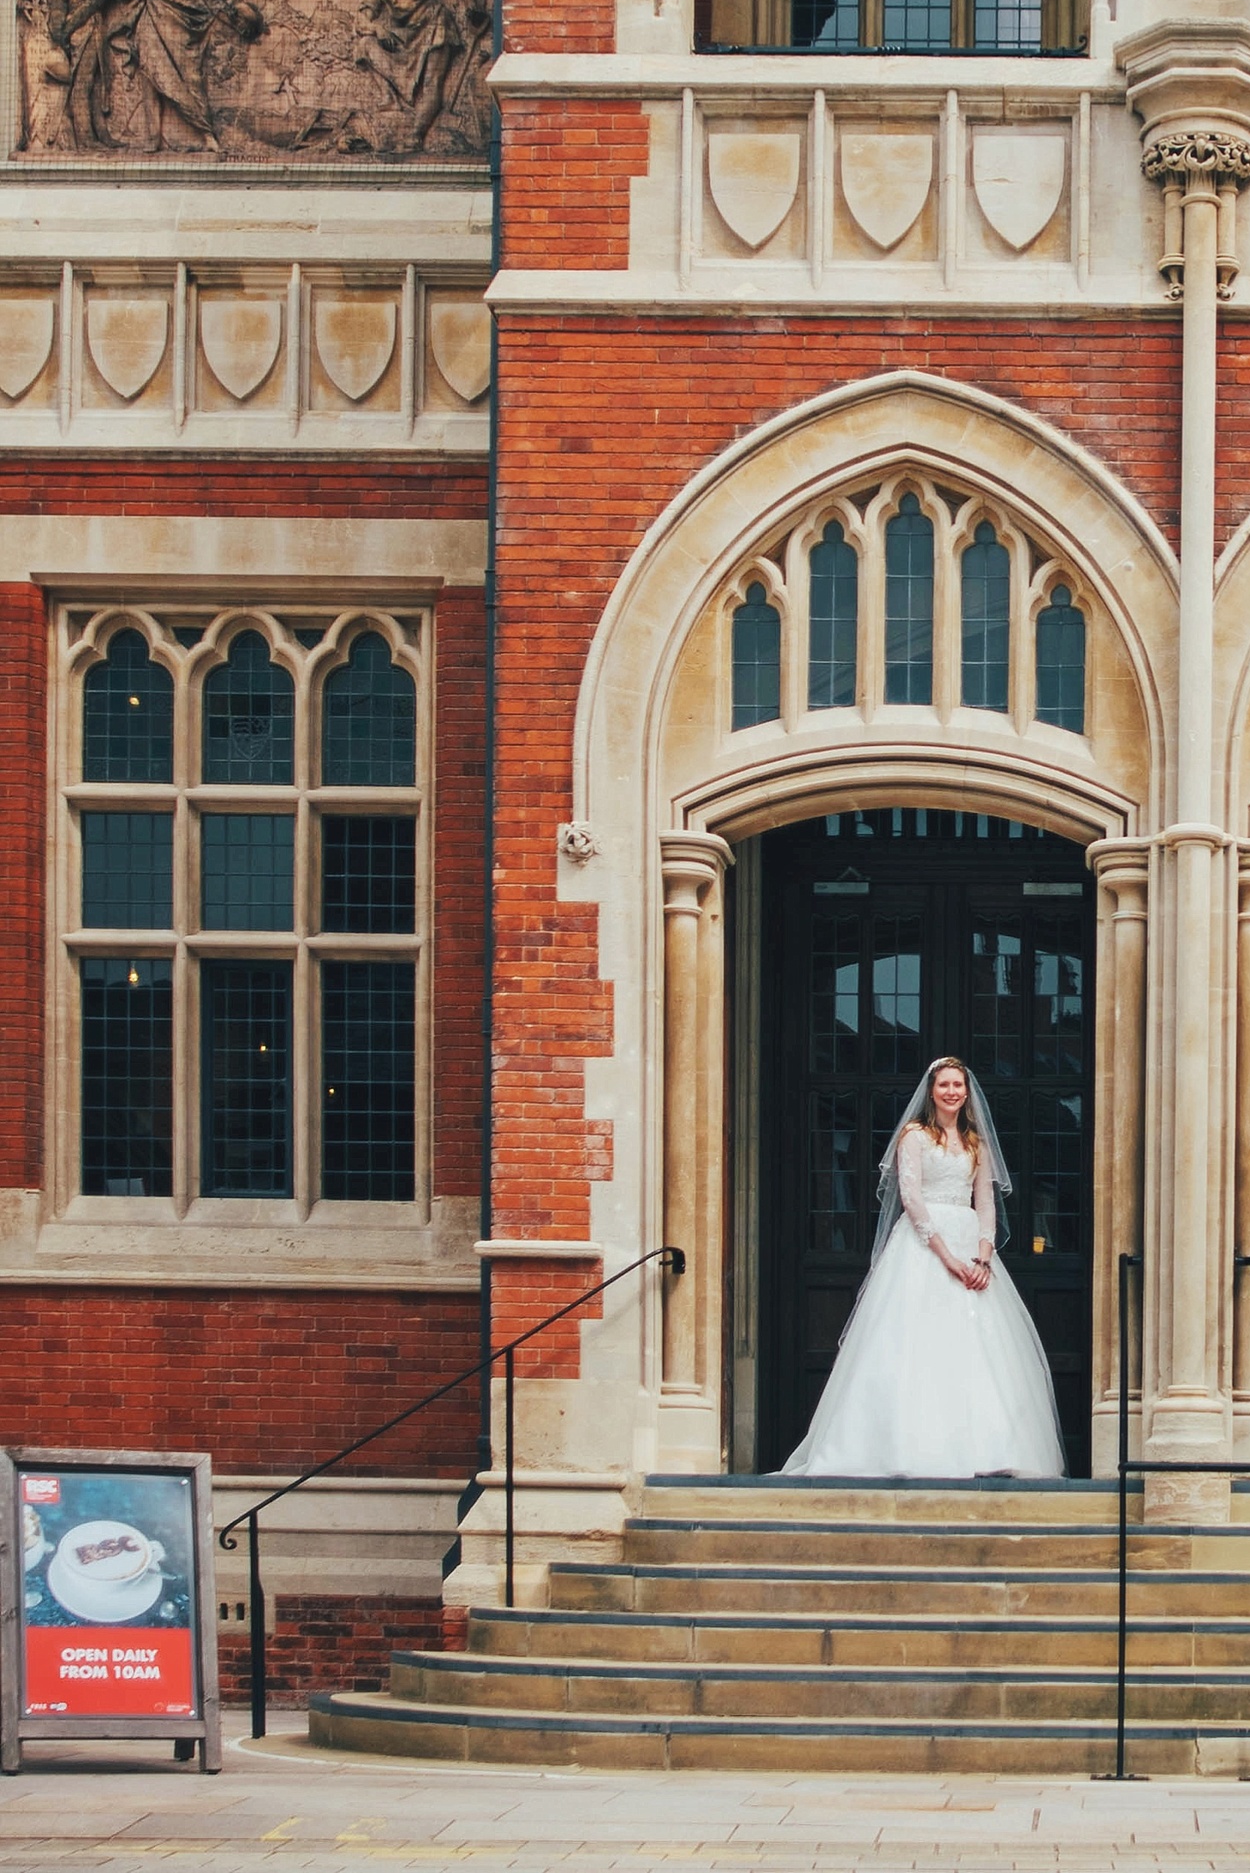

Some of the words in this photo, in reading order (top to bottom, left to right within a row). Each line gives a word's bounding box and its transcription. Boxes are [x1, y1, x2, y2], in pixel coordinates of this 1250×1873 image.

[75, 1535, 141, 1565] RSC
[61, 1648, 108, 1662] OPEN
[112, 1649, 158, 1662] DAILY
[59, 1665, 108, 1679] FROM
[113, 1666, 161, 1679] 10AM
